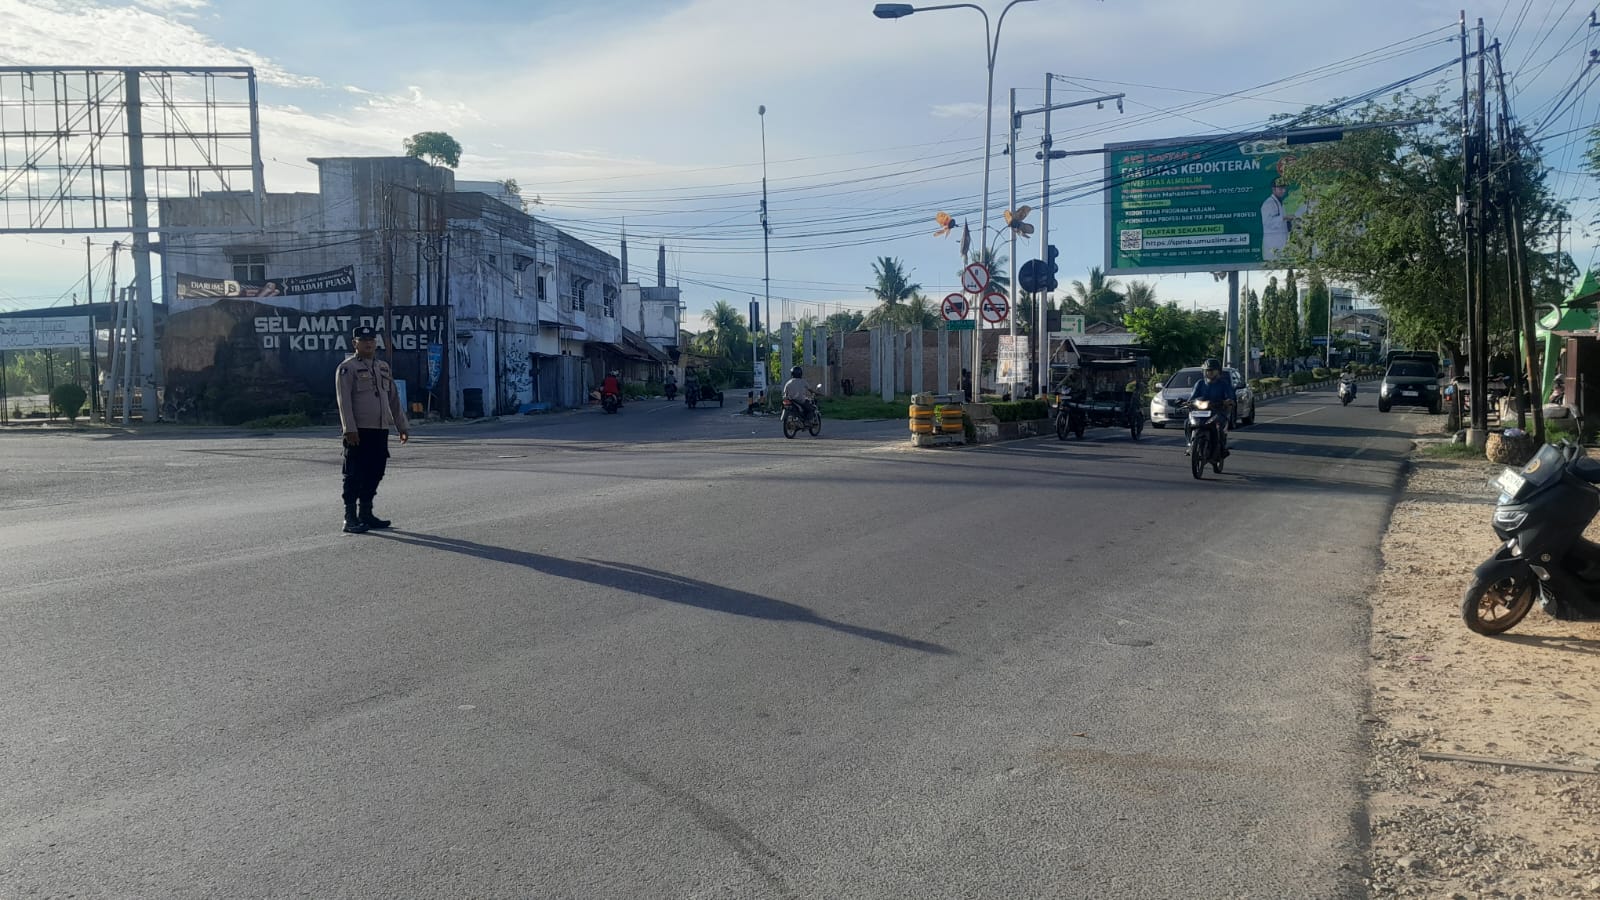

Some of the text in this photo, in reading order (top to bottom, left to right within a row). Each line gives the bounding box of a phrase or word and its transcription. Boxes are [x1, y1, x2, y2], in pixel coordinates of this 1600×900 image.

[1181, 159, 1260, 174] KEDOKTERAN
[1167, 176, 1203, 185] ALMUSLIM
[1145, 235, 1247, 247] https://spmb.umuslim.ac.id
[254, 315, 351, 332] SELAMAT
[263, 335, 280, 348] DI
[289, 335, 347, 350] KOTA
